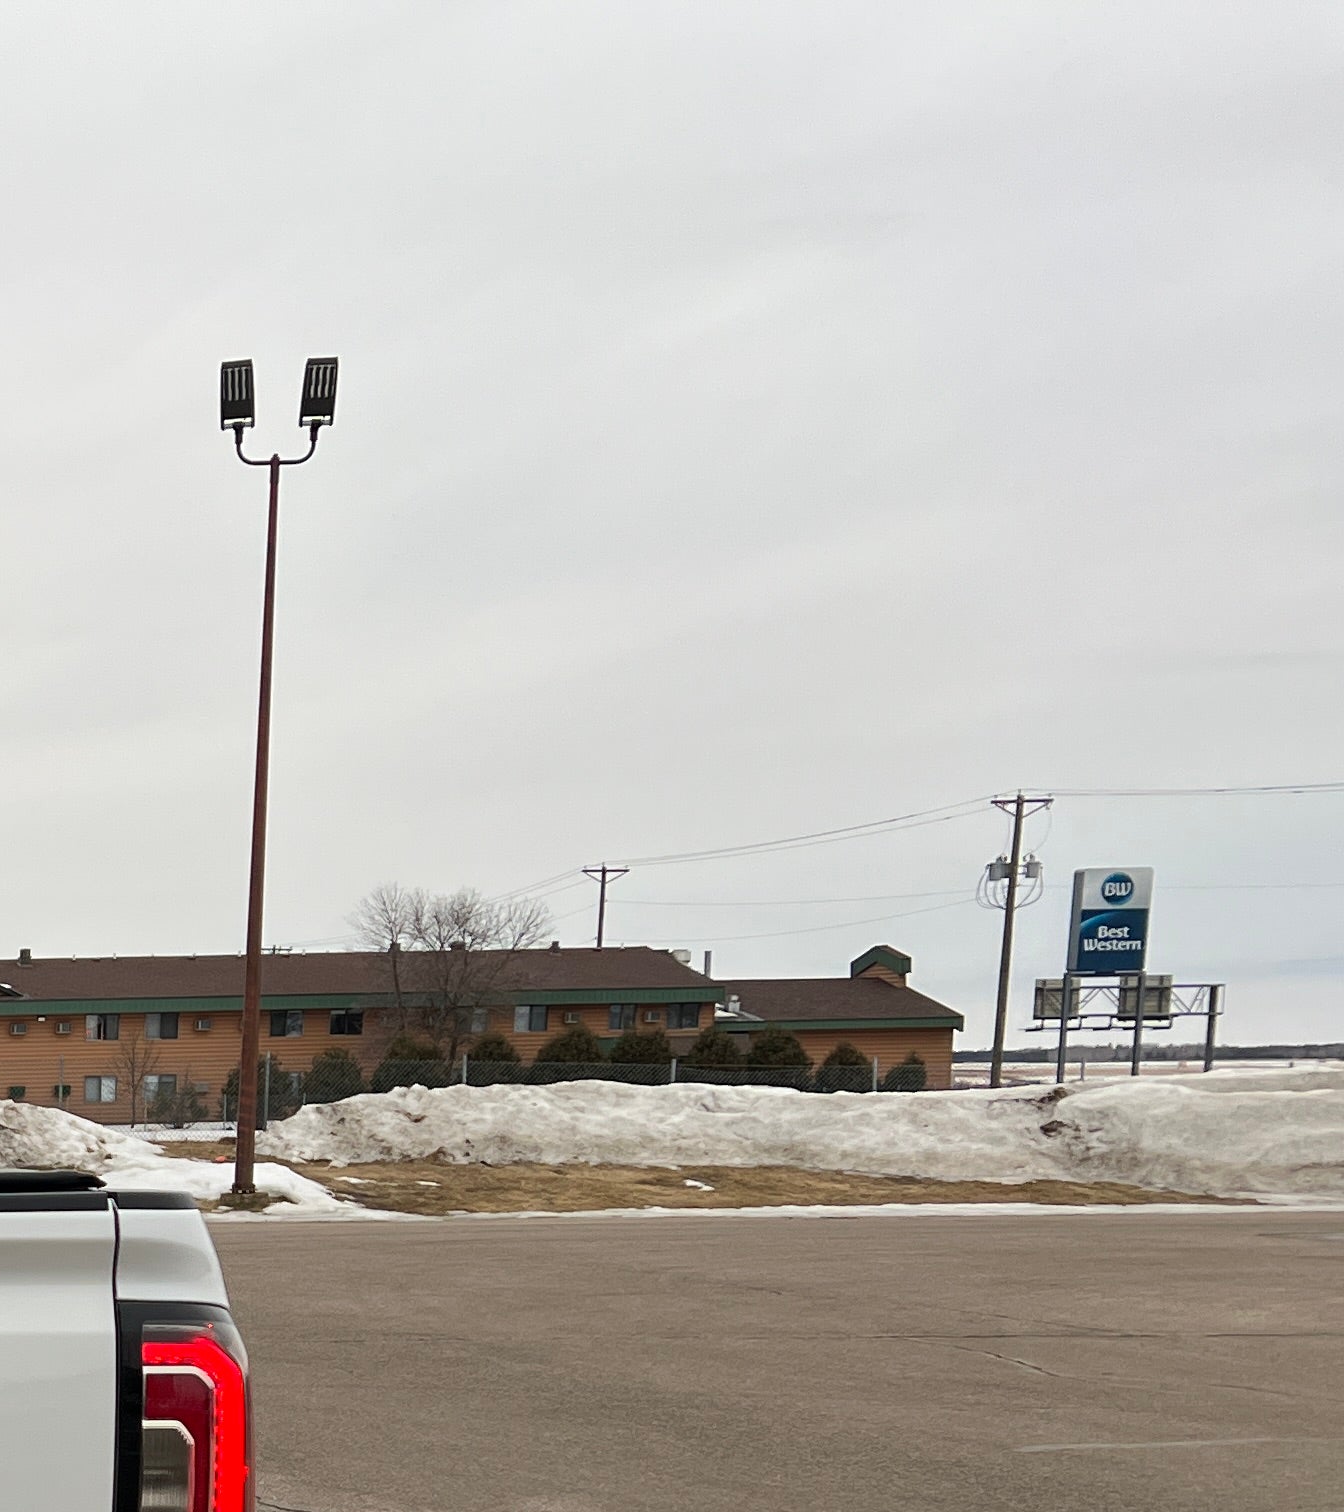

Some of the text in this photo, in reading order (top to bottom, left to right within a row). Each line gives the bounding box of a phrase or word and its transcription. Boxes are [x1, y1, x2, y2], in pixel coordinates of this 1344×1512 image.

[1105, 882, 1132, 896] BW
[1098, 926, 1130, 938] Best
[1084, 939, 1141, 951] Western
